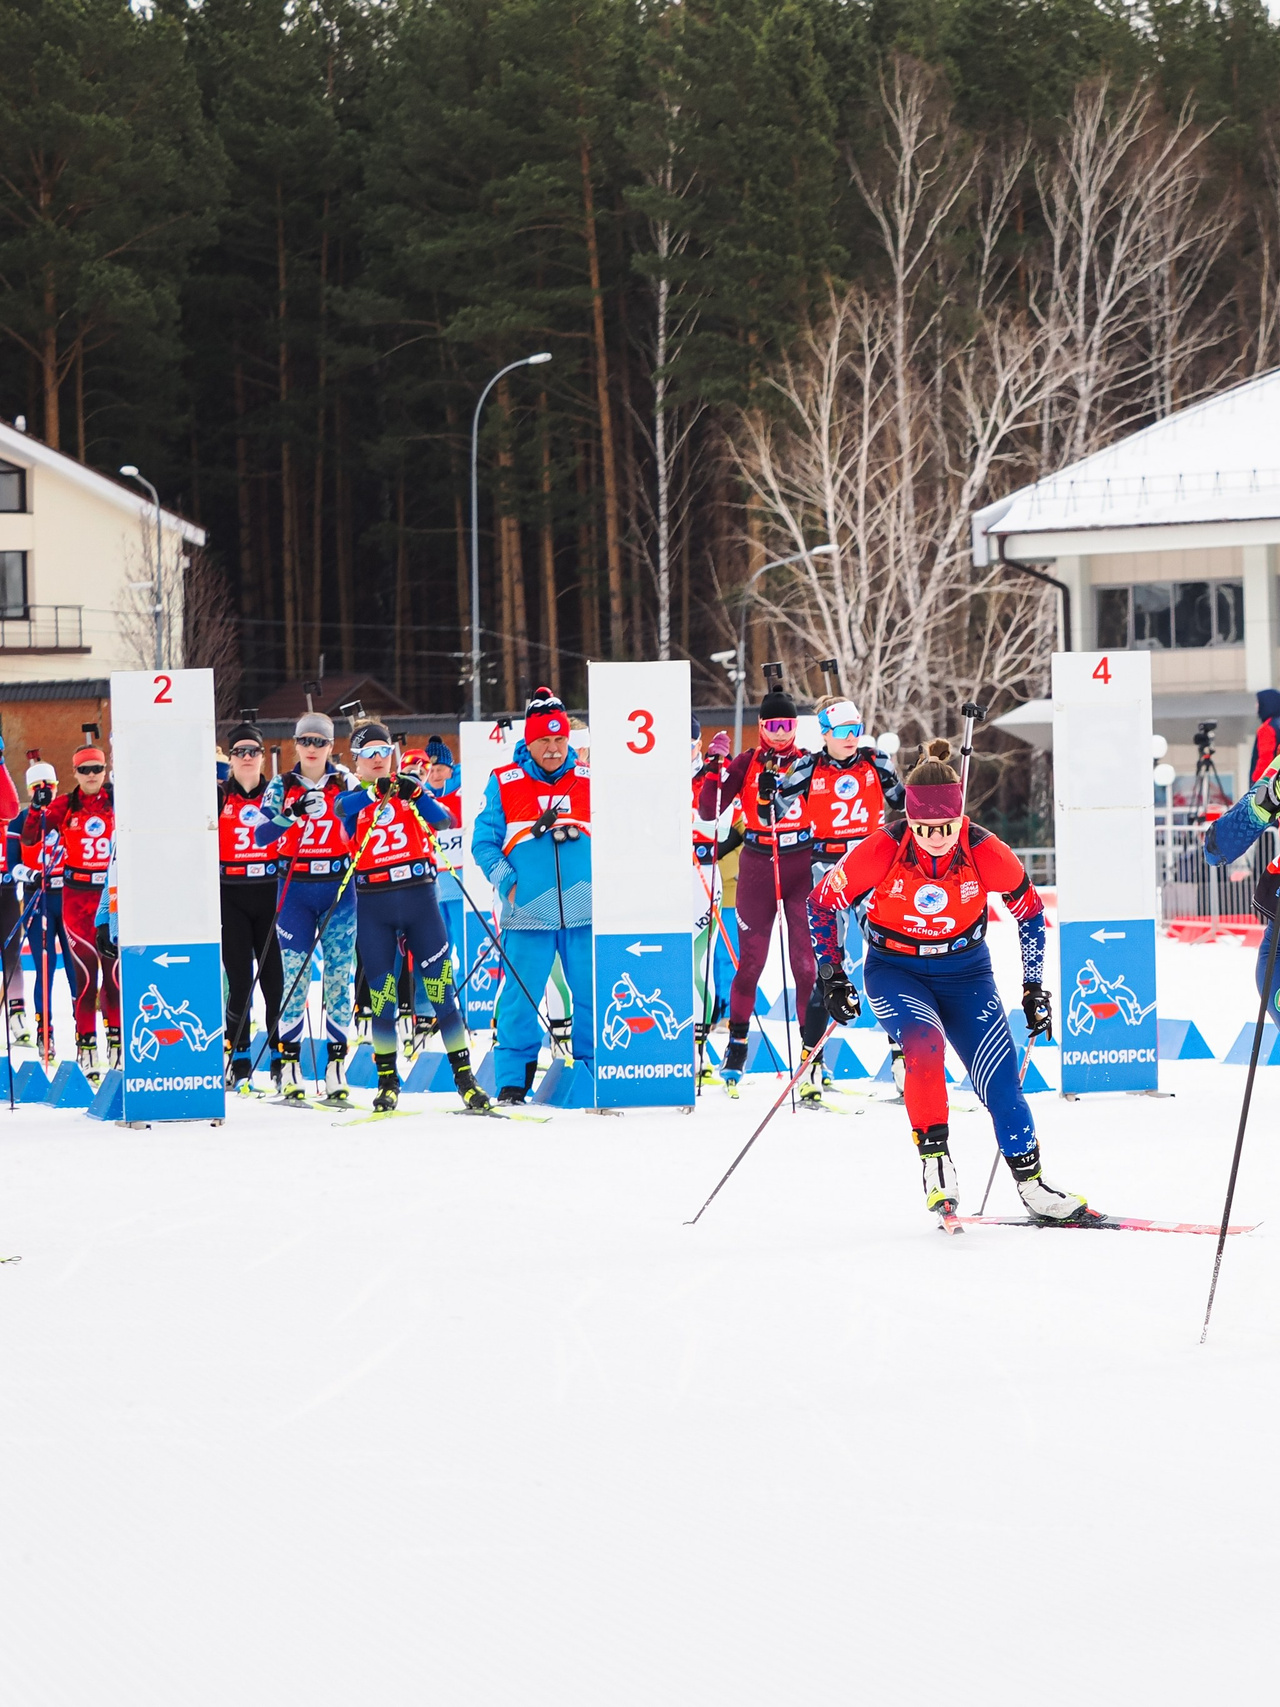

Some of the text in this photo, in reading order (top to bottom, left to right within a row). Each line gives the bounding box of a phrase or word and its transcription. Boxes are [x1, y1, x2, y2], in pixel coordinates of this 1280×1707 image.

[1092, 657, 1112, 685] 4
[153, 675, 173, 704] 2
[489, 725, 503, 743] 4
[626, 710, 656, 754] 3
[505, 770, 519, 781] 35
[785, 797, 803, 821] 8
[831, 799, 869, 827] 24
[234, 827, 268, 851] 3
[301, 820, 333, 845] 27
[370, 823, 408, 855] 23
[81, 837, 110, 859] 39
[1063, 1049, 1156, 1065] КРАСНОЯРСК
[126, 1075, 223, 1093] КРАСНОЯРСК
[598, 1064, 693, 1080] КРАСНОЯРСК
[1021, 1154, 1035, 1164] 172
